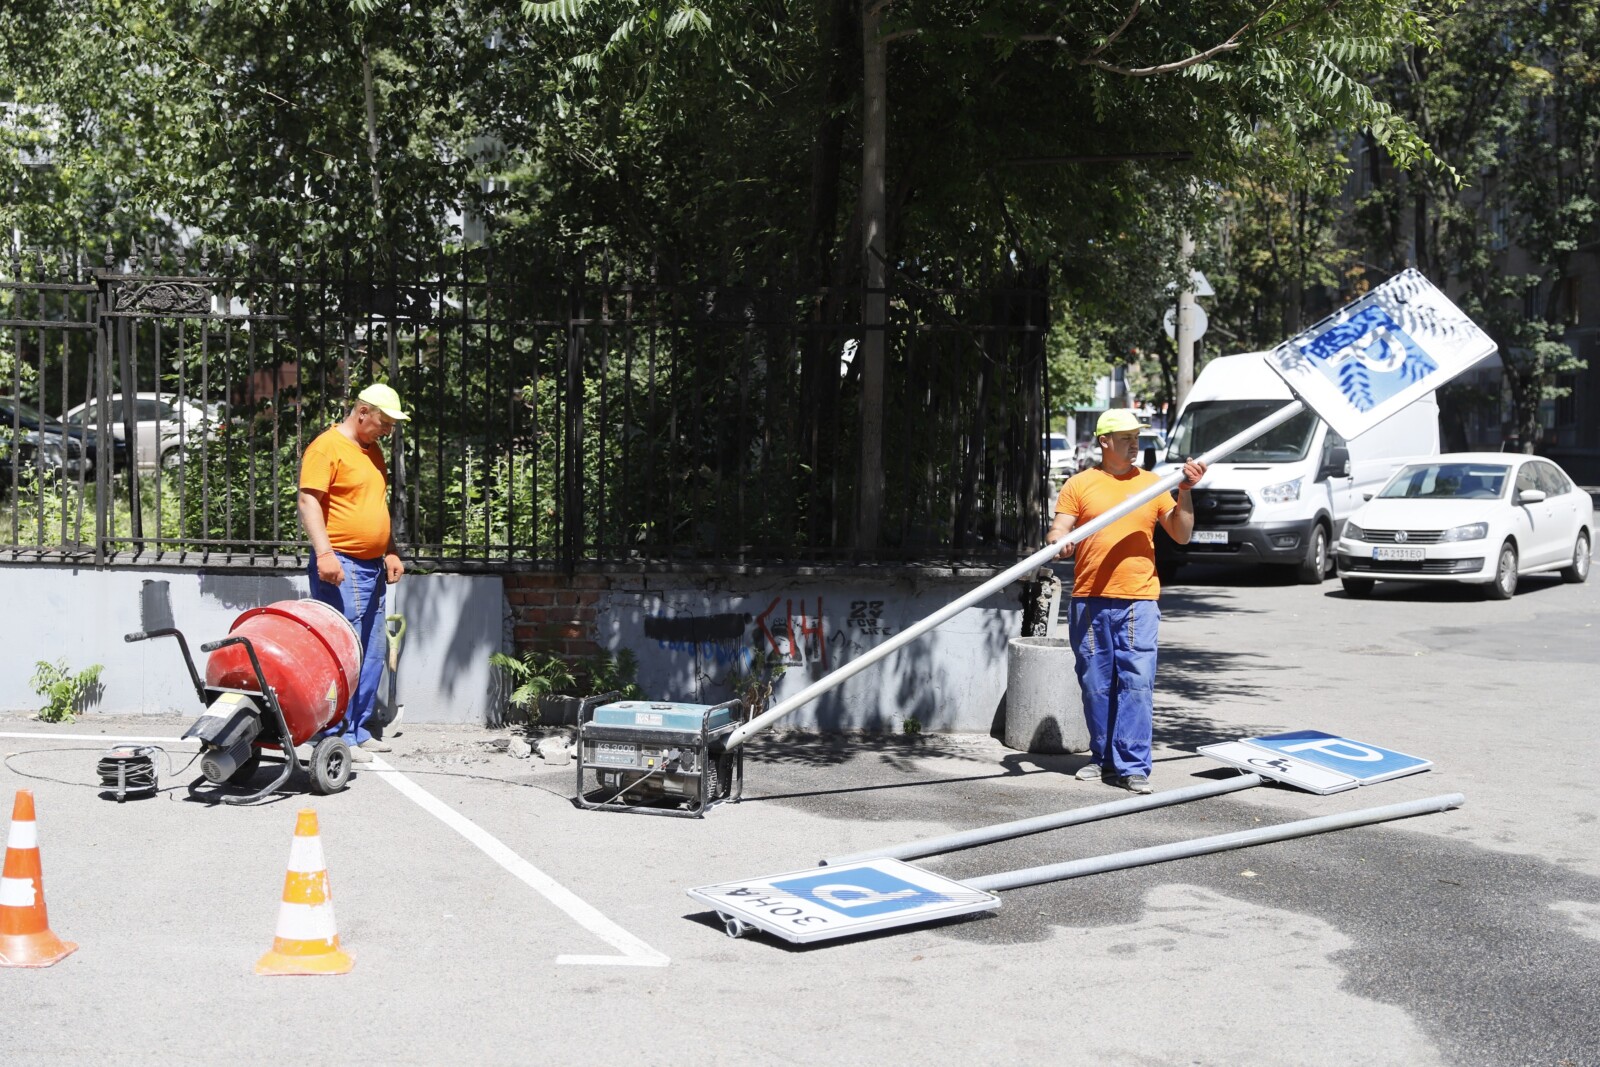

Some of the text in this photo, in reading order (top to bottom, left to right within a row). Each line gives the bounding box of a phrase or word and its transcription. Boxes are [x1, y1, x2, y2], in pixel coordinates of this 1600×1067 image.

[1326, 326, 1406, 372] P
[1379, 549, 1389, 557] AA
[1390, 550, 1408, 558] 2131
[597, 742, 636, 753] KS 3000
[1279, 738, 1384, 762] P
[726, 887, 830, 926] ЗОНА
[812, 884, 922, 909] P
